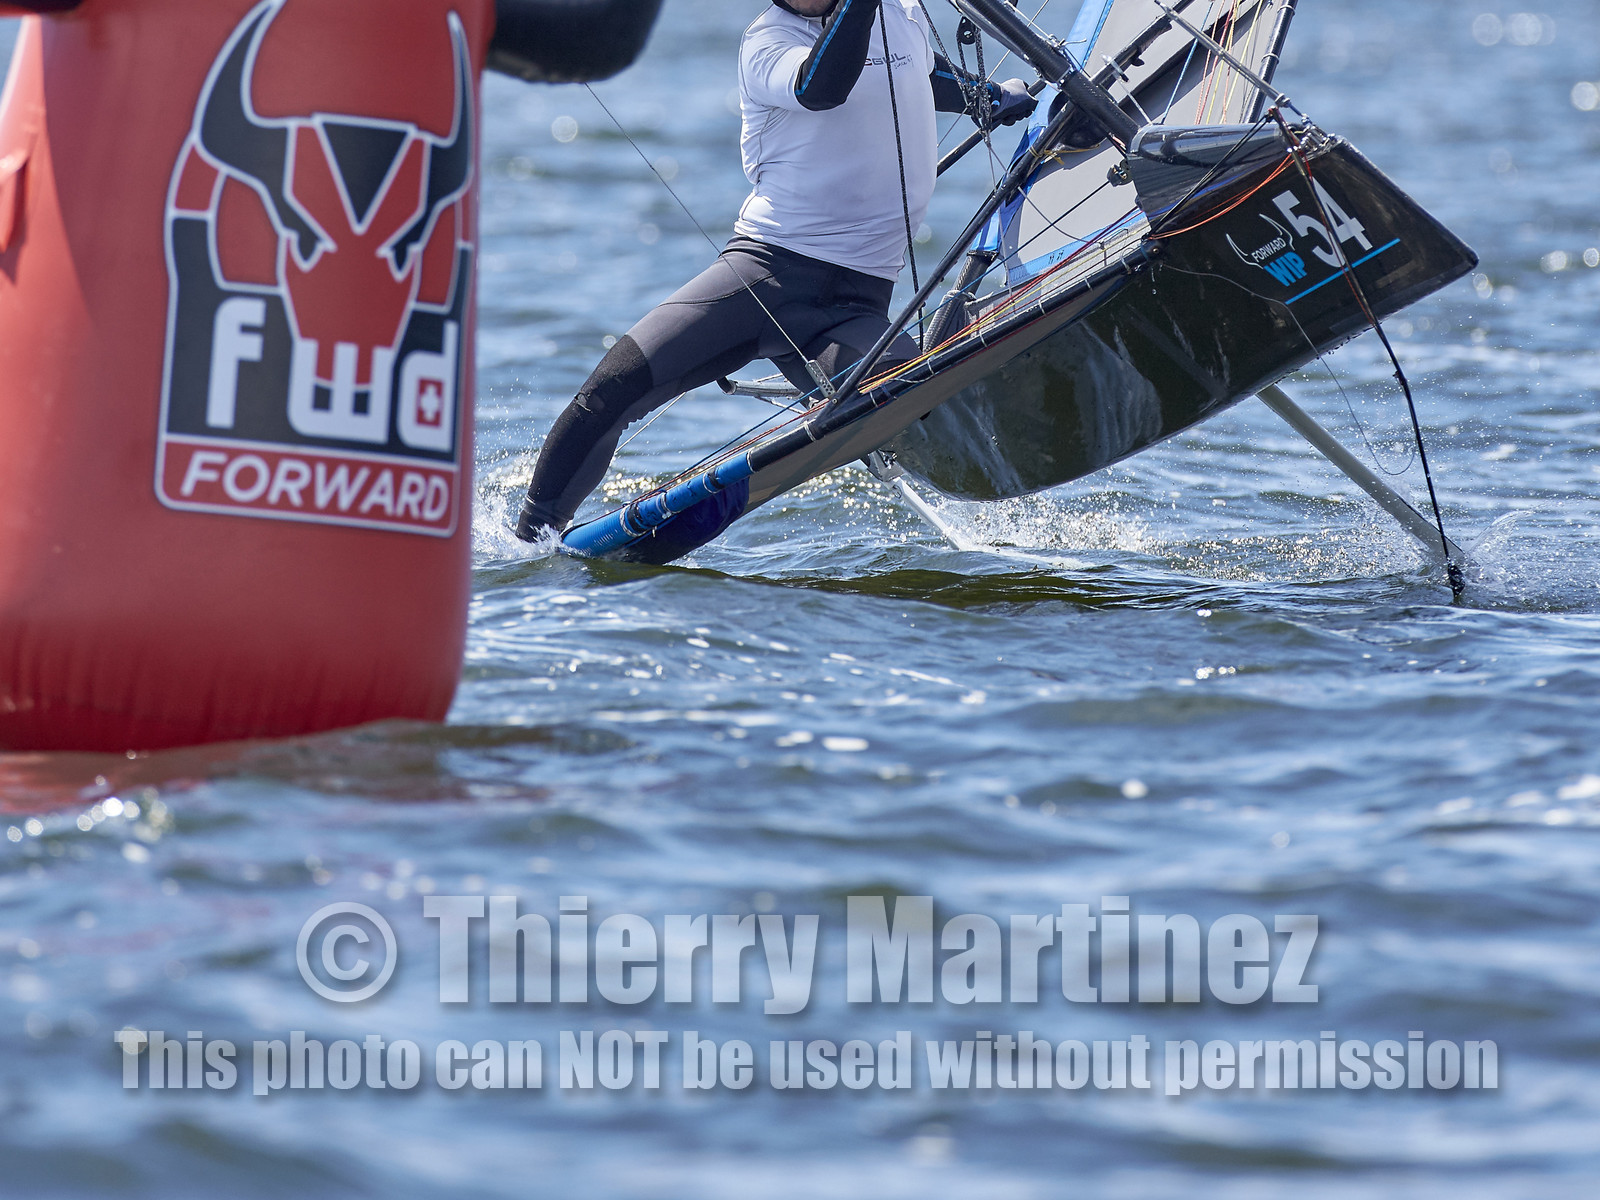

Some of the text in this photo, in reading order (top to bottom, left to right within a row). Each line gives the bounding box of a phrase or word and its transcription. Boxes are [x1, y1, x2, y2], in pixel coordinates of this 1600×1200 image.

[1272, 176, 1373, 268] 54
[1251, 237, 1287, 262] FORWARD
[1263, 251, 1308, 287] WIP
[180, 451, 449, 521] FORWARD
